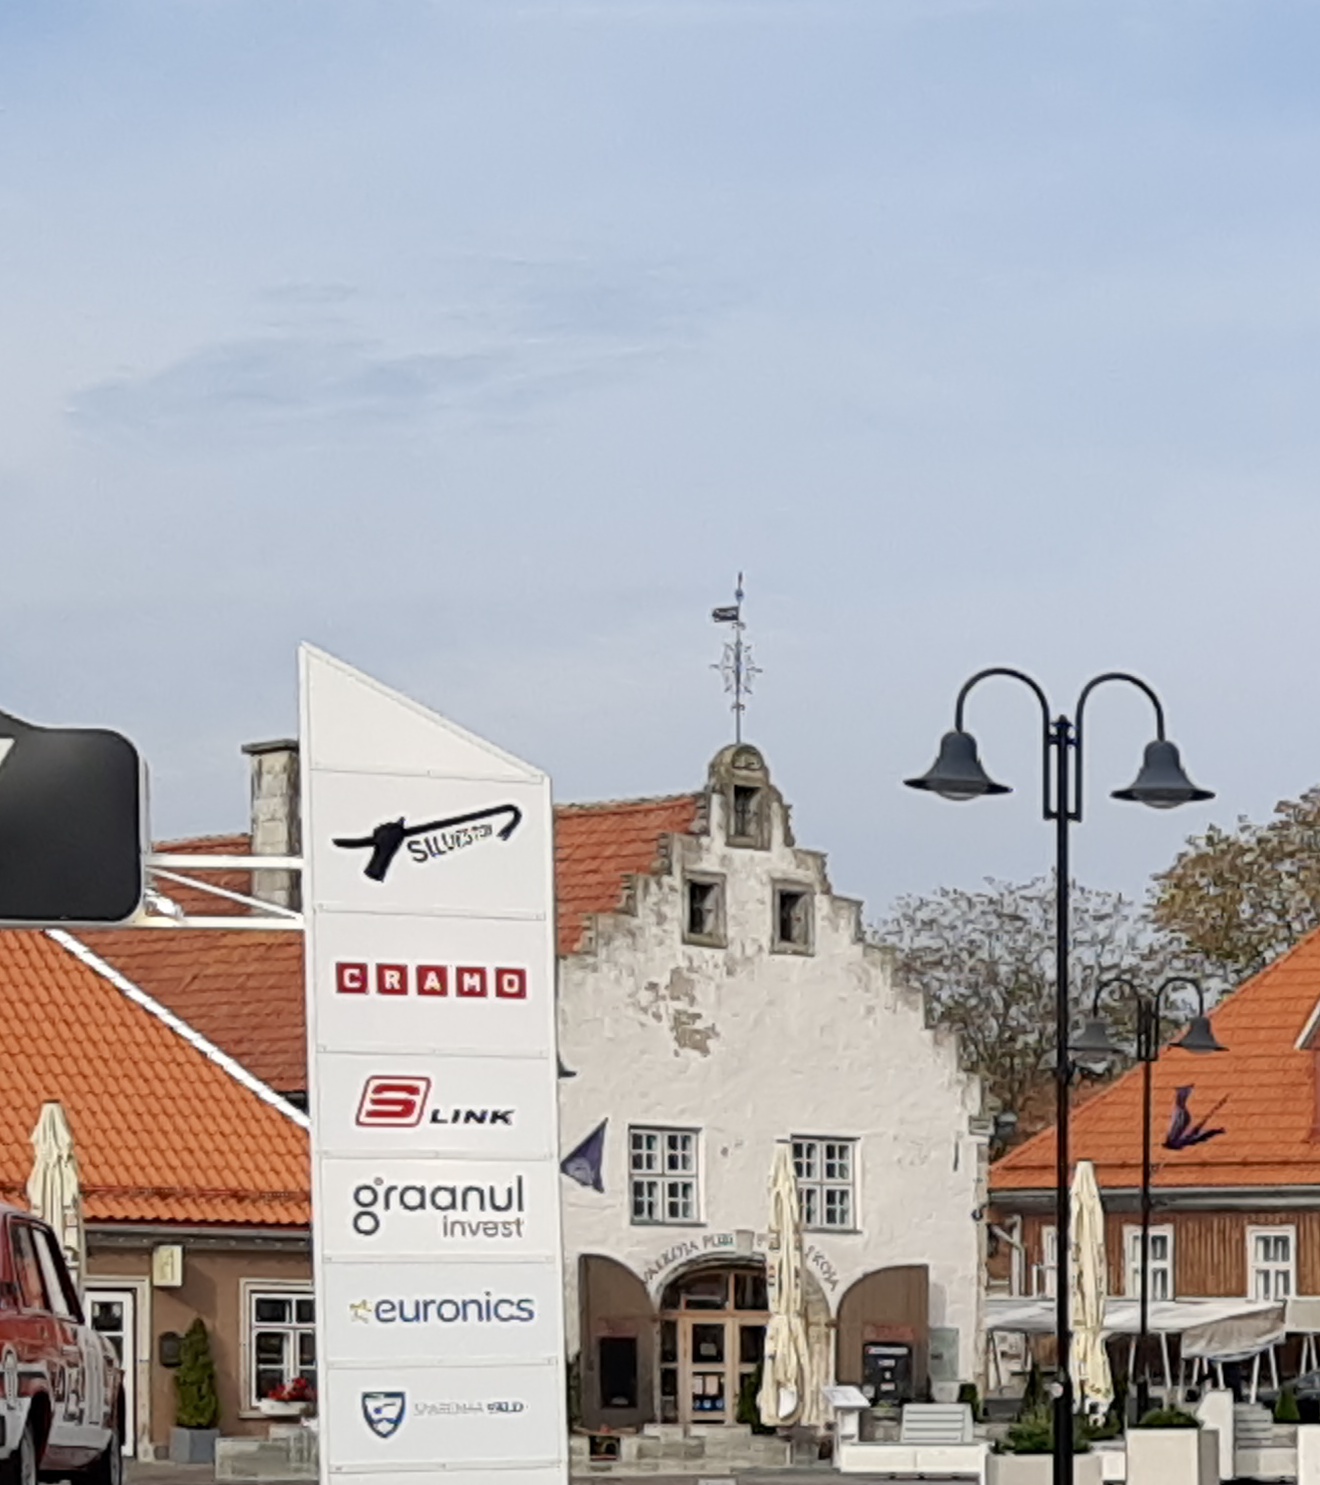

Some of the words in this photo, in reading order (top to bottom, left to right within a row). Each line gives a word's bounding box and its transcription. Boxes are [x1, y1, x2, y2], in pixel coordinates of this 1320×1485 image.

[341, 966, 522, 995] CRAMO
[429, 1108, 517, 1126] LINK
[352, 1174, 526, 1237] graanul
[442, 1214, 525, 1239] invest
[373, 1290, 536, 1324] euronics
